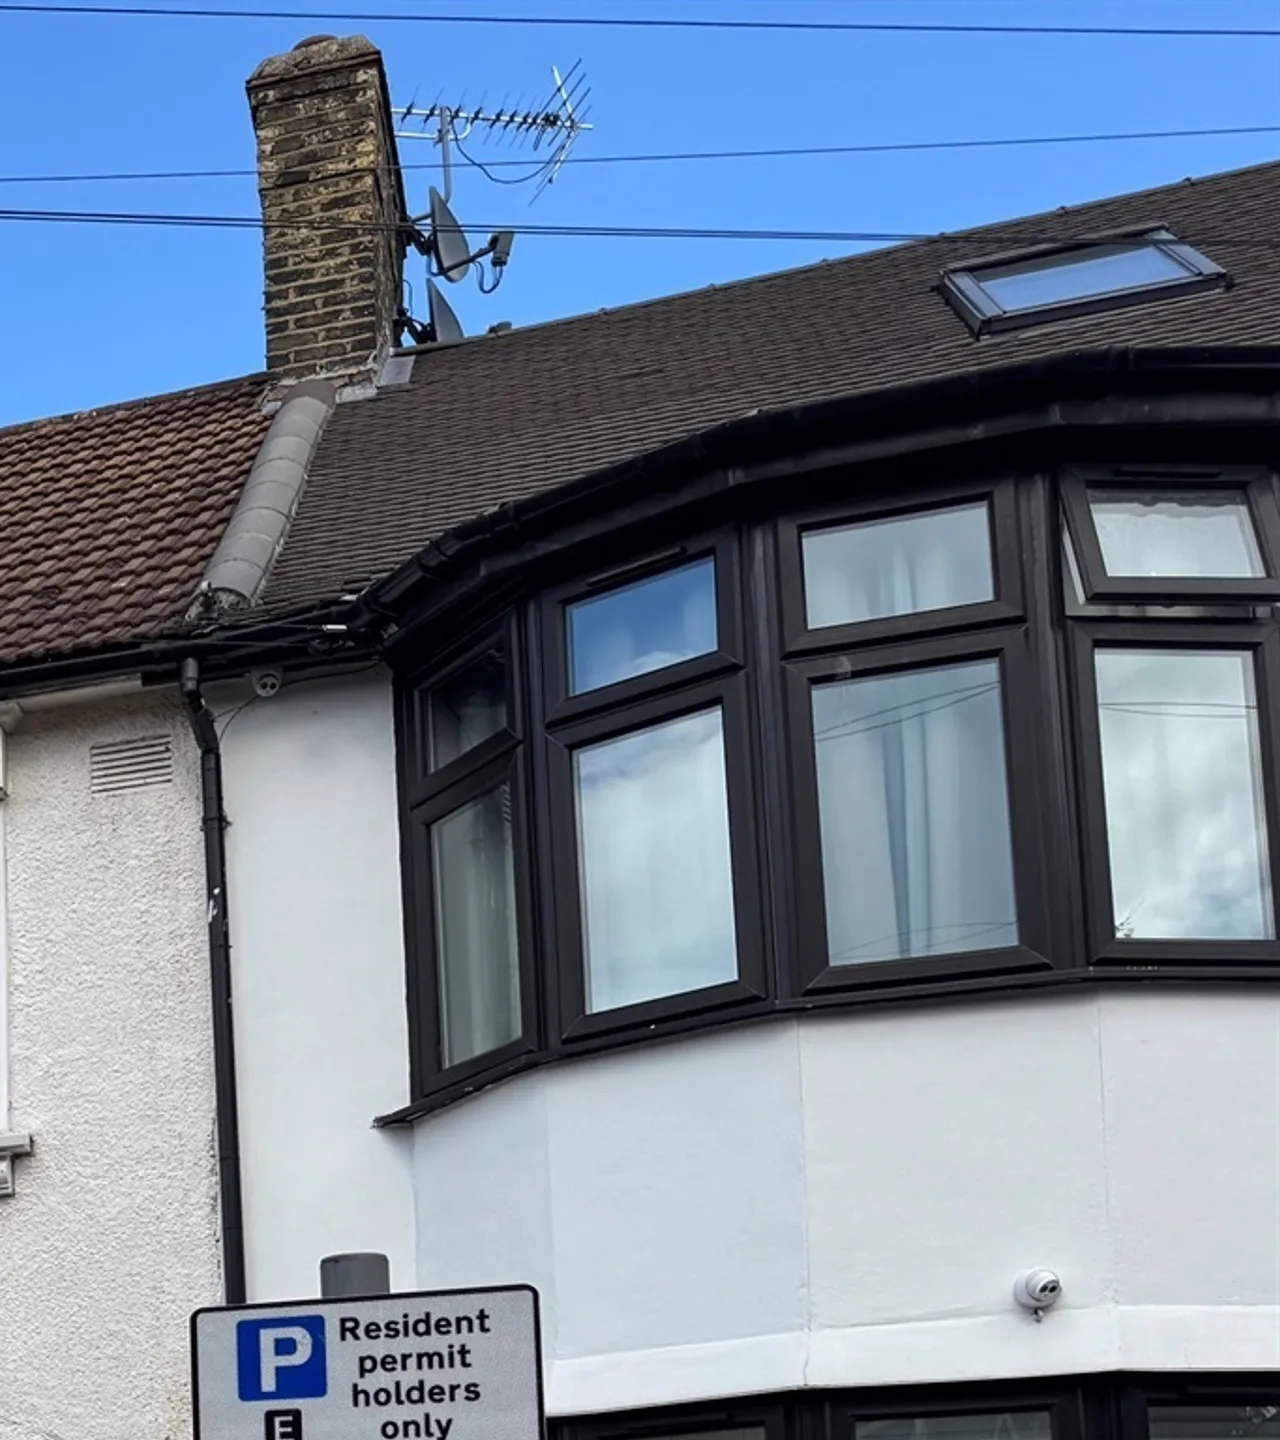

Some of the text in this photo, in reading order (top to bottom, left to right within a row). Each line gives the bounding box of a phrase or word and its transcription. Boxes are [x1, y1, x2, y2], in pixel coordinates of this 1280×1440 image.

[340, 1309, 490, 1341] Resident
[259, 1326, 313, 1393] P
[358, 1344, 472, 1378] permit
[352, 1380, 481, 1408] holders
